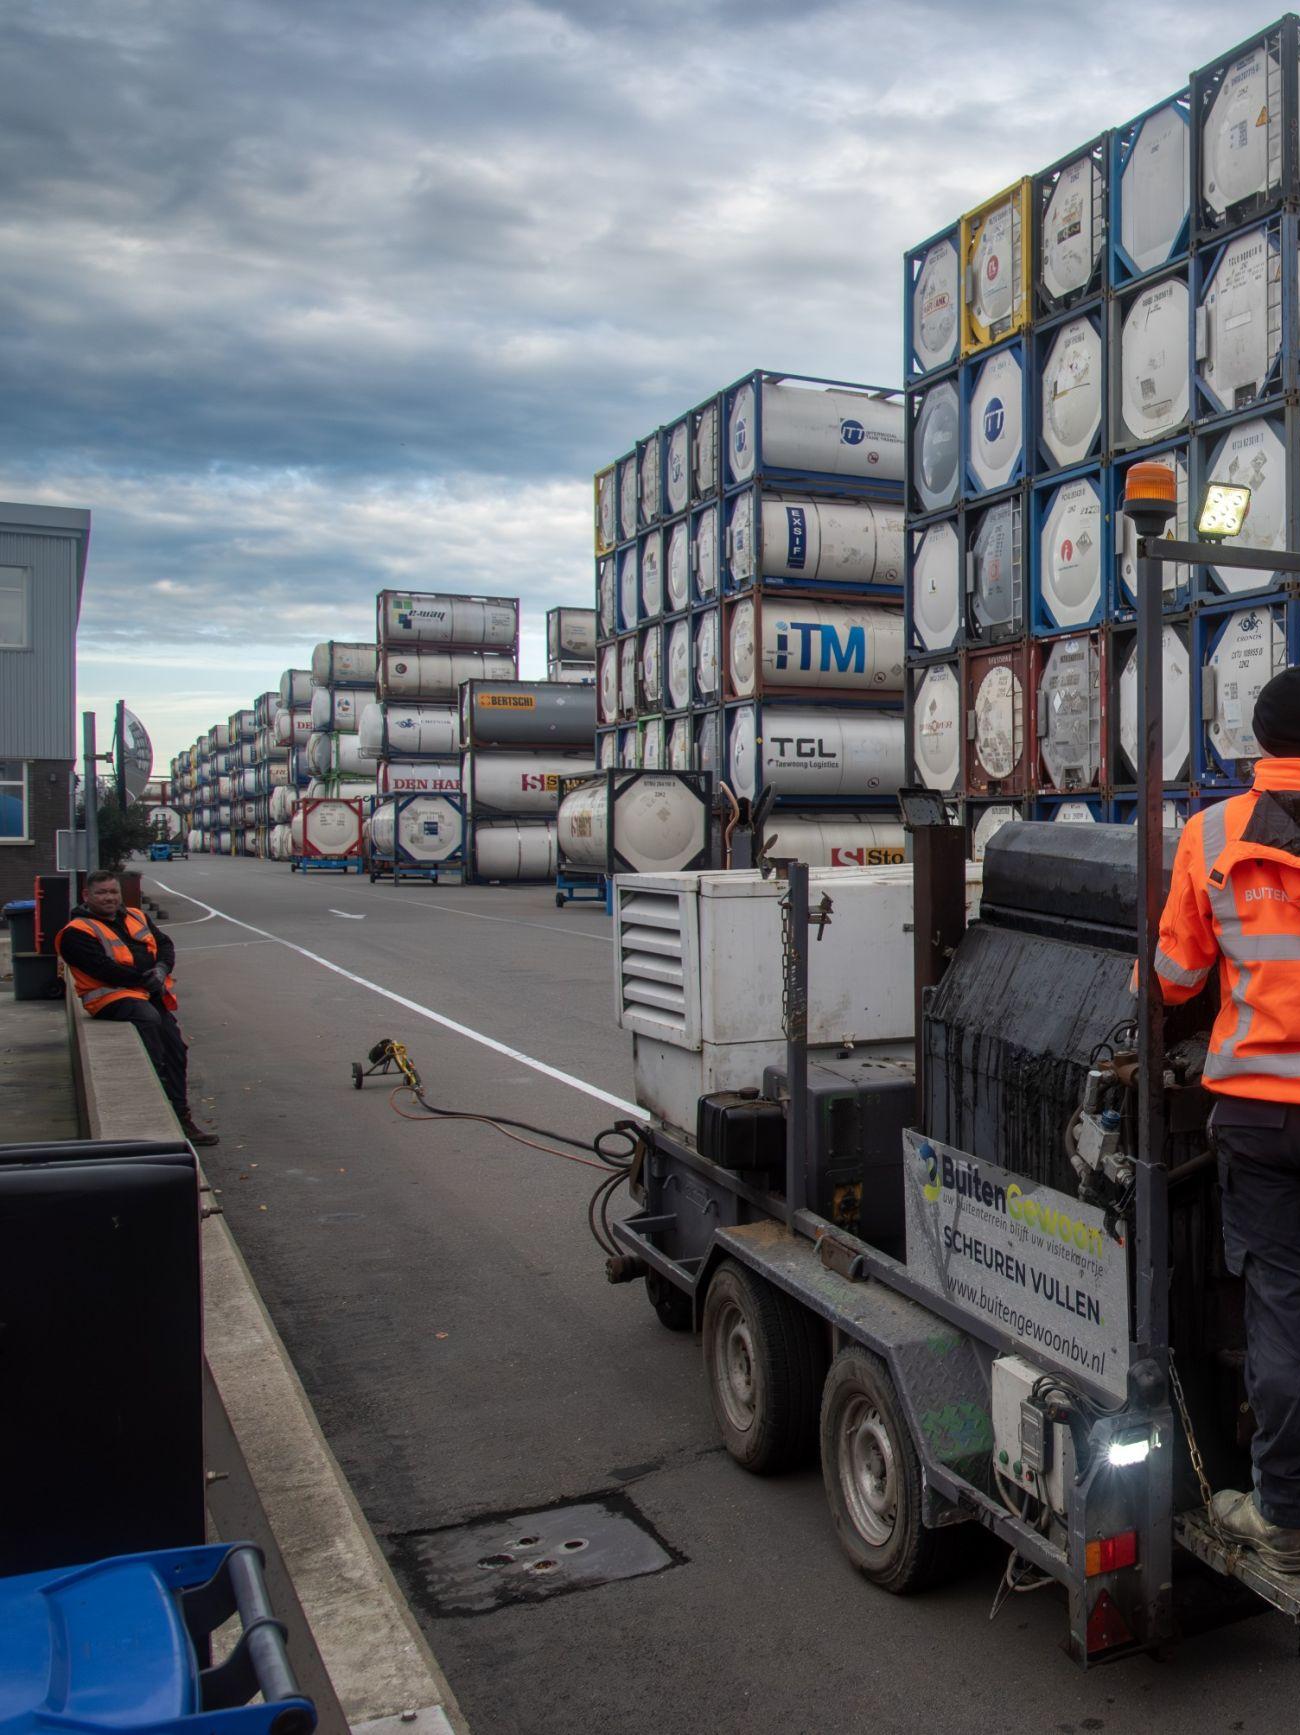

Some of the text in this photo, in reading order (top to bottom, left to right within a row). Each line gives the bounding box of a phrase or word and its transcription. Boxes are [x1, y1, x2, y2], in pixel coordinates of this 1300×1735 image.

[792, 509, 802, 555] EXSIF
[775, 621, 865, 673] iTM
[491, 695, 533, 707] BERTSCHI
[770, 738, 837, 758] TGL
[810, 761, 840, 769] Logistics
[393, 779, 428, 789] DEN
[1245, 887, 1289, 902] BUITEN
[956, 1197, 1008, 1233] buitenterrein
[1010, 1220, 1030, 1243] blijft
[1032, 1234, 1044, 1250] uw
[1047, 1239, 1104, 1277] visitekaartje
[943, 1225, 1026, 1287] SCHEUREN
[947, 1274, 1106, 1376] www.buitengewoonbv.nl
